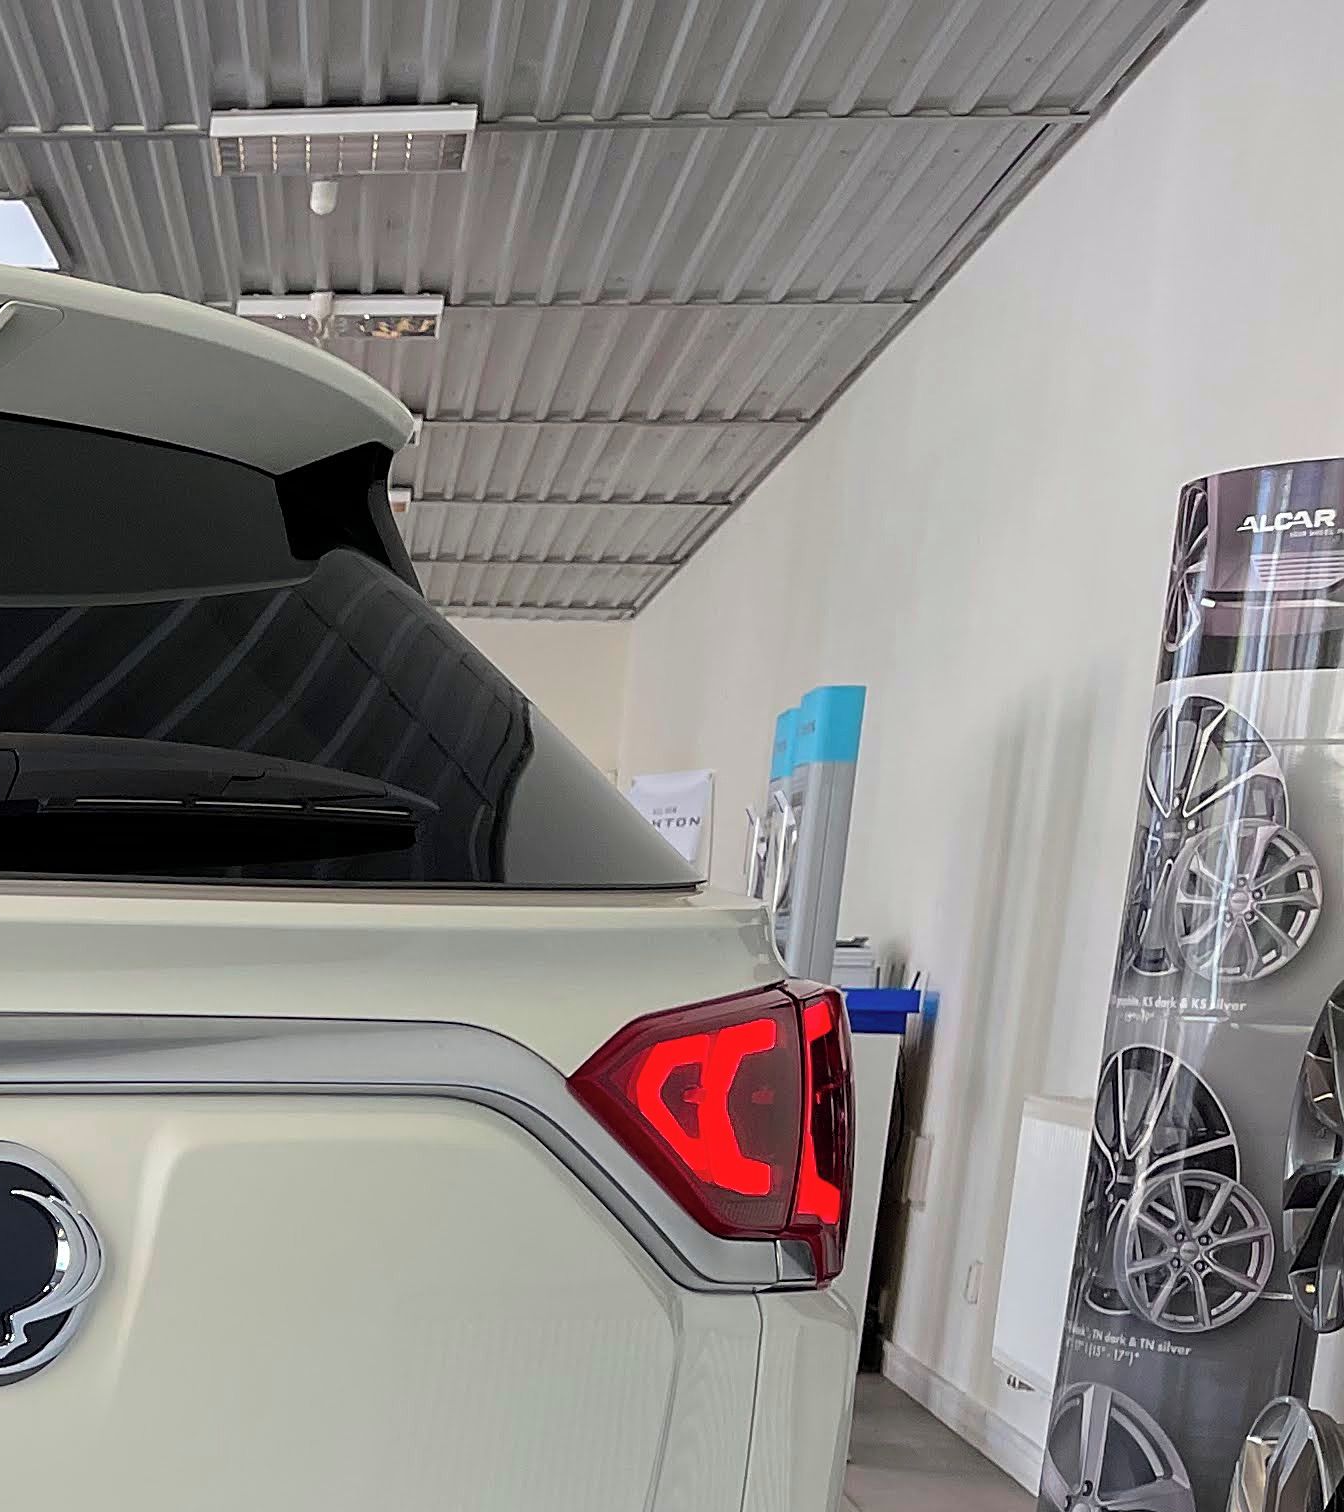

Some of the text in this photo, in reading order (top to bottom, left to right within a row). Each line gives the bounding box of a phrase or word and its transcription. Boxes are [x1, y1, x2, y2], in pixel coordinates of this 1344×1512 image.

[1236, 508, 1337, 534] ALCAR
[1191, 997, 1207, 1010] KS
[1157, 1340, 1192, 1356] silver
